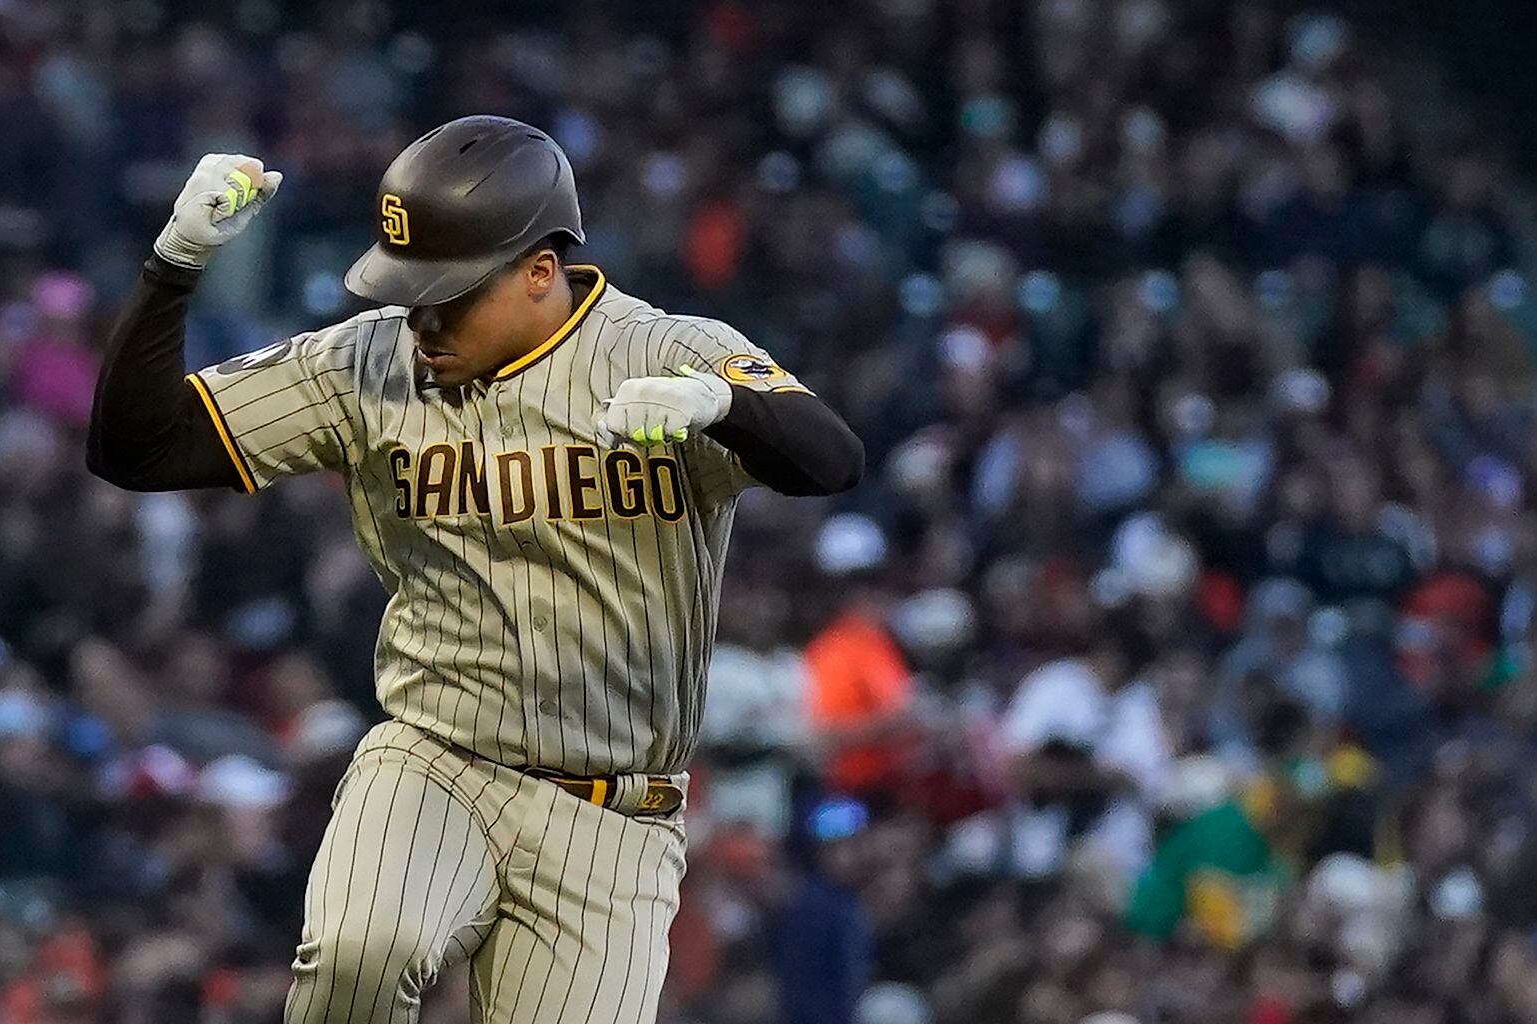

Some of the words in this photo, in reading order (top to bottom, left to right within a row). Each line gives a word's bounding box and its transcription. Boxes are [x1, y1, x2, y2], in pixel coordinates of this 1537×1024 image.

[381, 193, 410, 245] SD
[389, 440, 491, 520] SAN
[494, 444, 686, 527] DIEGO
